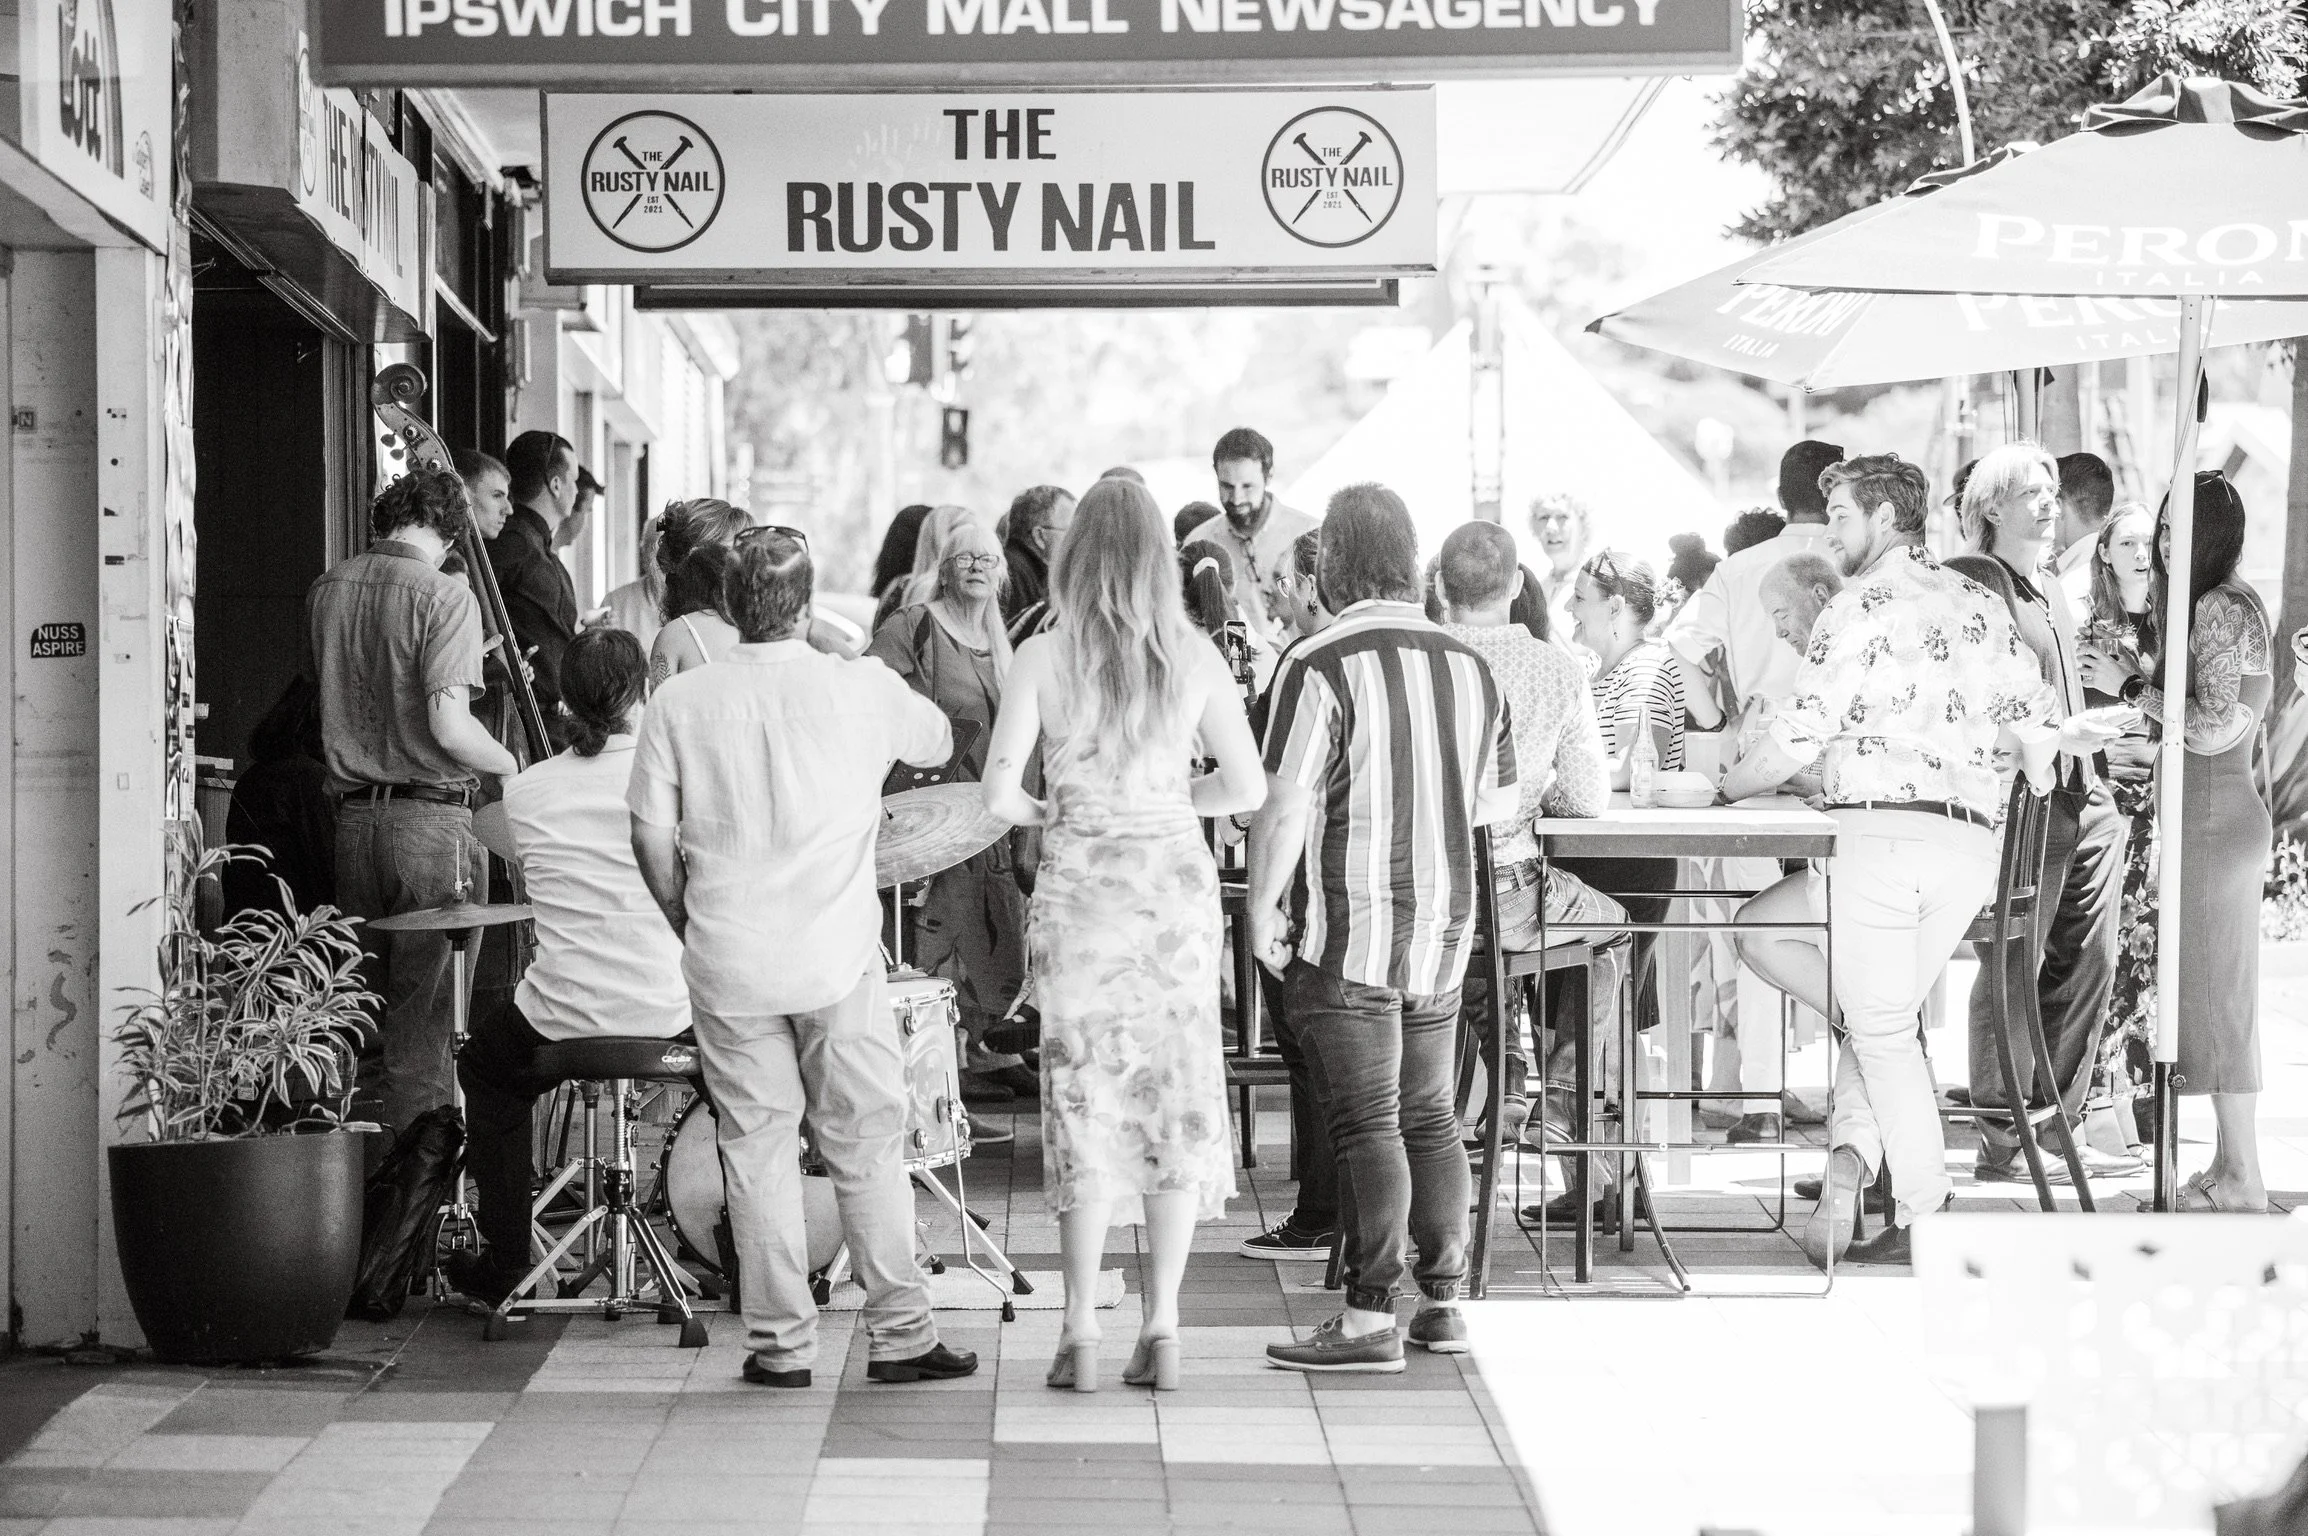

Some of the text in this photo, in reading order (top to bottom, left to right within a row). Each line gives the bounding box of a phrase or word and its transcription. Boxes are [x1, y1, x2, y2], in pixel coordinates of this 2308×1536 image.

[384, 0, 1662, 37] IPSWICH CITY MALL NEWSAGENCY
[943, 108, 1057, 160] THE
[641, 151, 663, 162] THE
[1321, 147, 1343, 158] THE
[591, 171, 715, 192] RUSTY NAIL
[1271, 166, 1393, 189] RUSTY NAIL
[647, 196, 659, 204] EST
[1326, 191, 1338, 199] EST
[643, 205, 663, 214] 2021
[786, 181, 1216, 253] RUSTY NAIL
[2096, 270, 2265, 287] ITALIA
[1721, 333, 1781, 359] ITALIA
[38, 625, 79, 641] NUSS
[32, 640, 85, 657] ASPIRE
